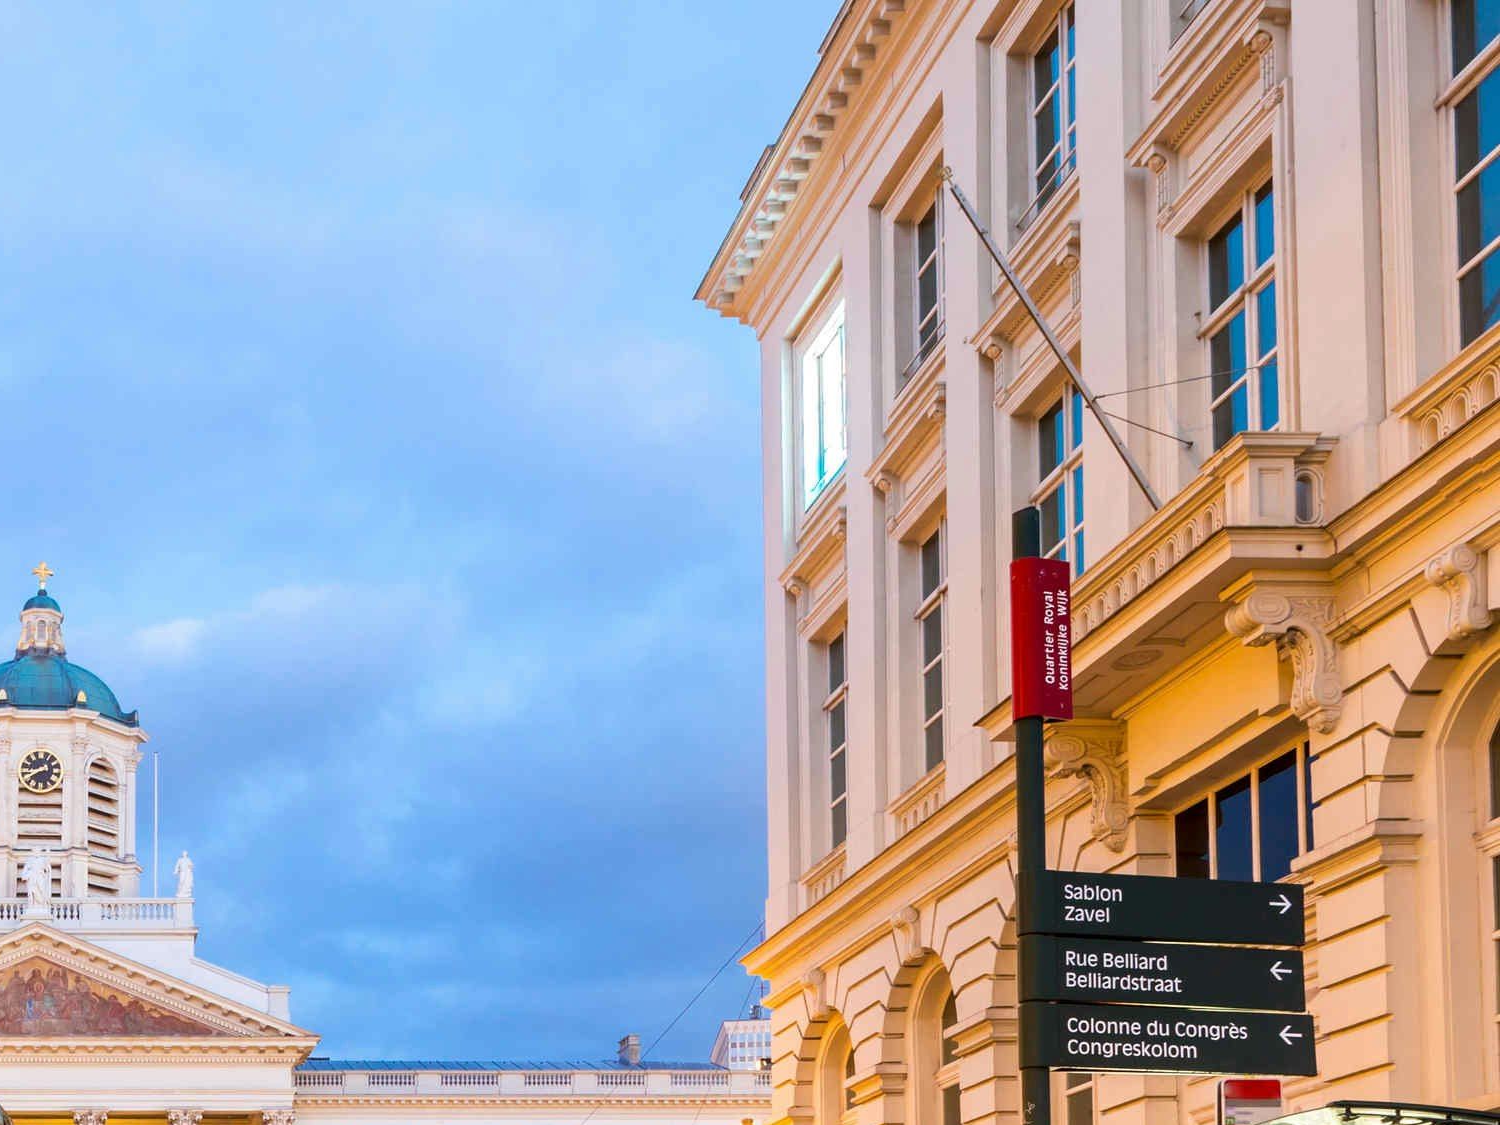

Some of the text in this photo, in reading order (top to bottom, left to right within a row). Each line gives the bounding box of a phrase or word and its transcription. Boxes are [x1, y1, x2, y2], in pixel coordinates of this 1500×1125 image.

[1044, 591, 1055, 684] Quartier Royal
[1057, 590, 1069, 690] Koninklijke Wijk
[1064, 884, 1123, 902] Sablon
[1064, 905, 1110, 923] Zavel
[1065, 950, 1168, 971] Rue Belliard
[1065, 972, 1182, 993] Belliardstraat
[1067, 1017, 1248, 1040] Colonne du Congrès
[1067, 1039, 1197, 1059] Congreskolom
